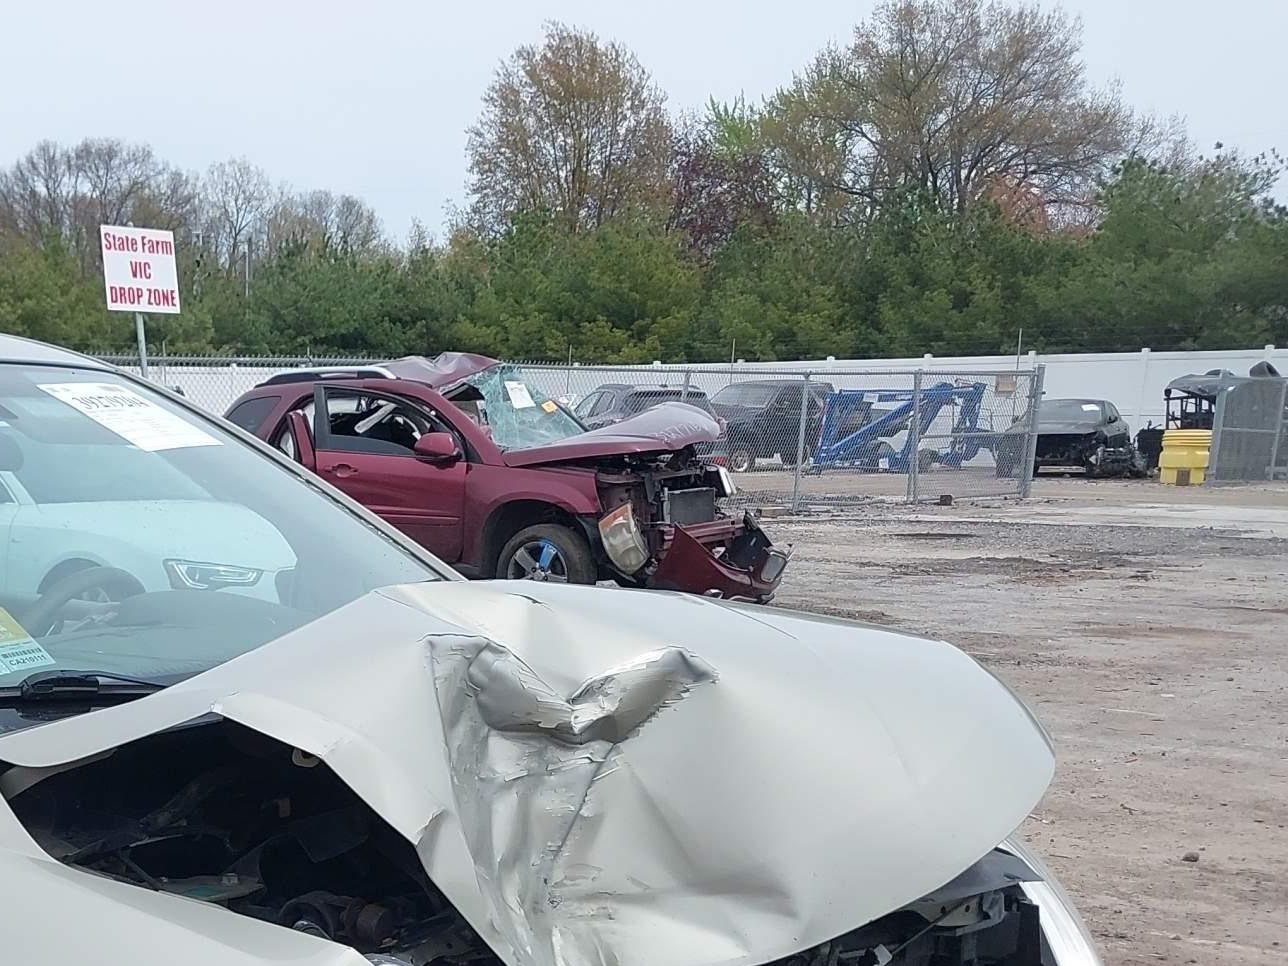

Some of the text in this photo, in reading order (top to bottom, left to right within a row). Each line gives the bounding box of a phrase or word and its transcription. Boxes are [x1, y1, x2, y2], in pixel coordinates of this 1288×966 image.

[103, 232, 173, 255] State Farm
[129, 260, 152, 279] VIC
[109, 286, 177, 307] DROP ZONE
